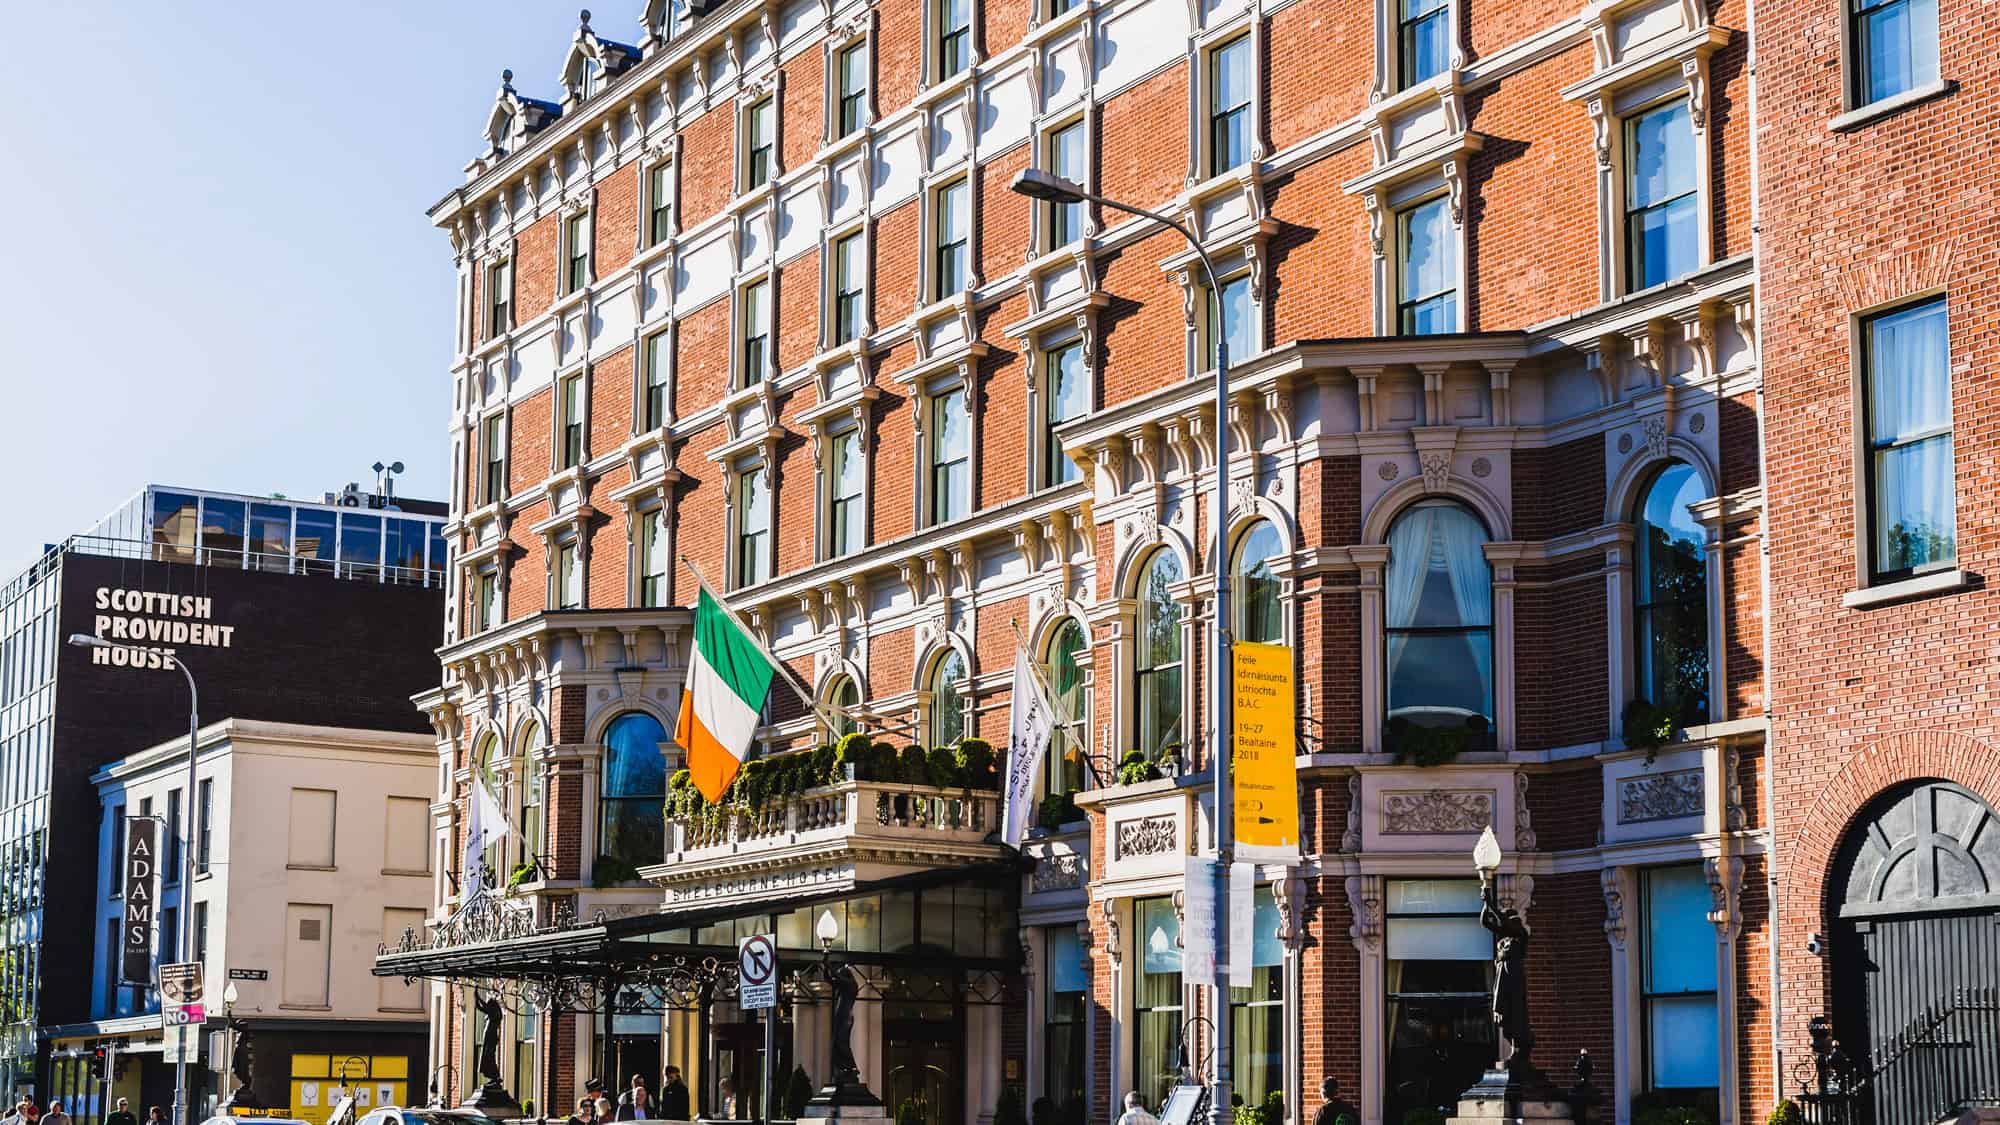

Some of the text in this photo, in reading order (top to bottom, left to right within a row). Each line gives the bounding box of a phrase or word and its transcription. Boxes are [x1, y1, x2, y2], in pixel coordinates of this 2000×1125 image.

[95, 587, 212, 619] SCOTTISH
[95, 615, 234, 647] PROVIDENT
[93, 646, 176, 670] HOUSE
[128, 837, 150, 944] ADAMS
[673, 865, 848, 902] SHELBOURNE HOTEL
[165, 1010, 189, 1025] NO
